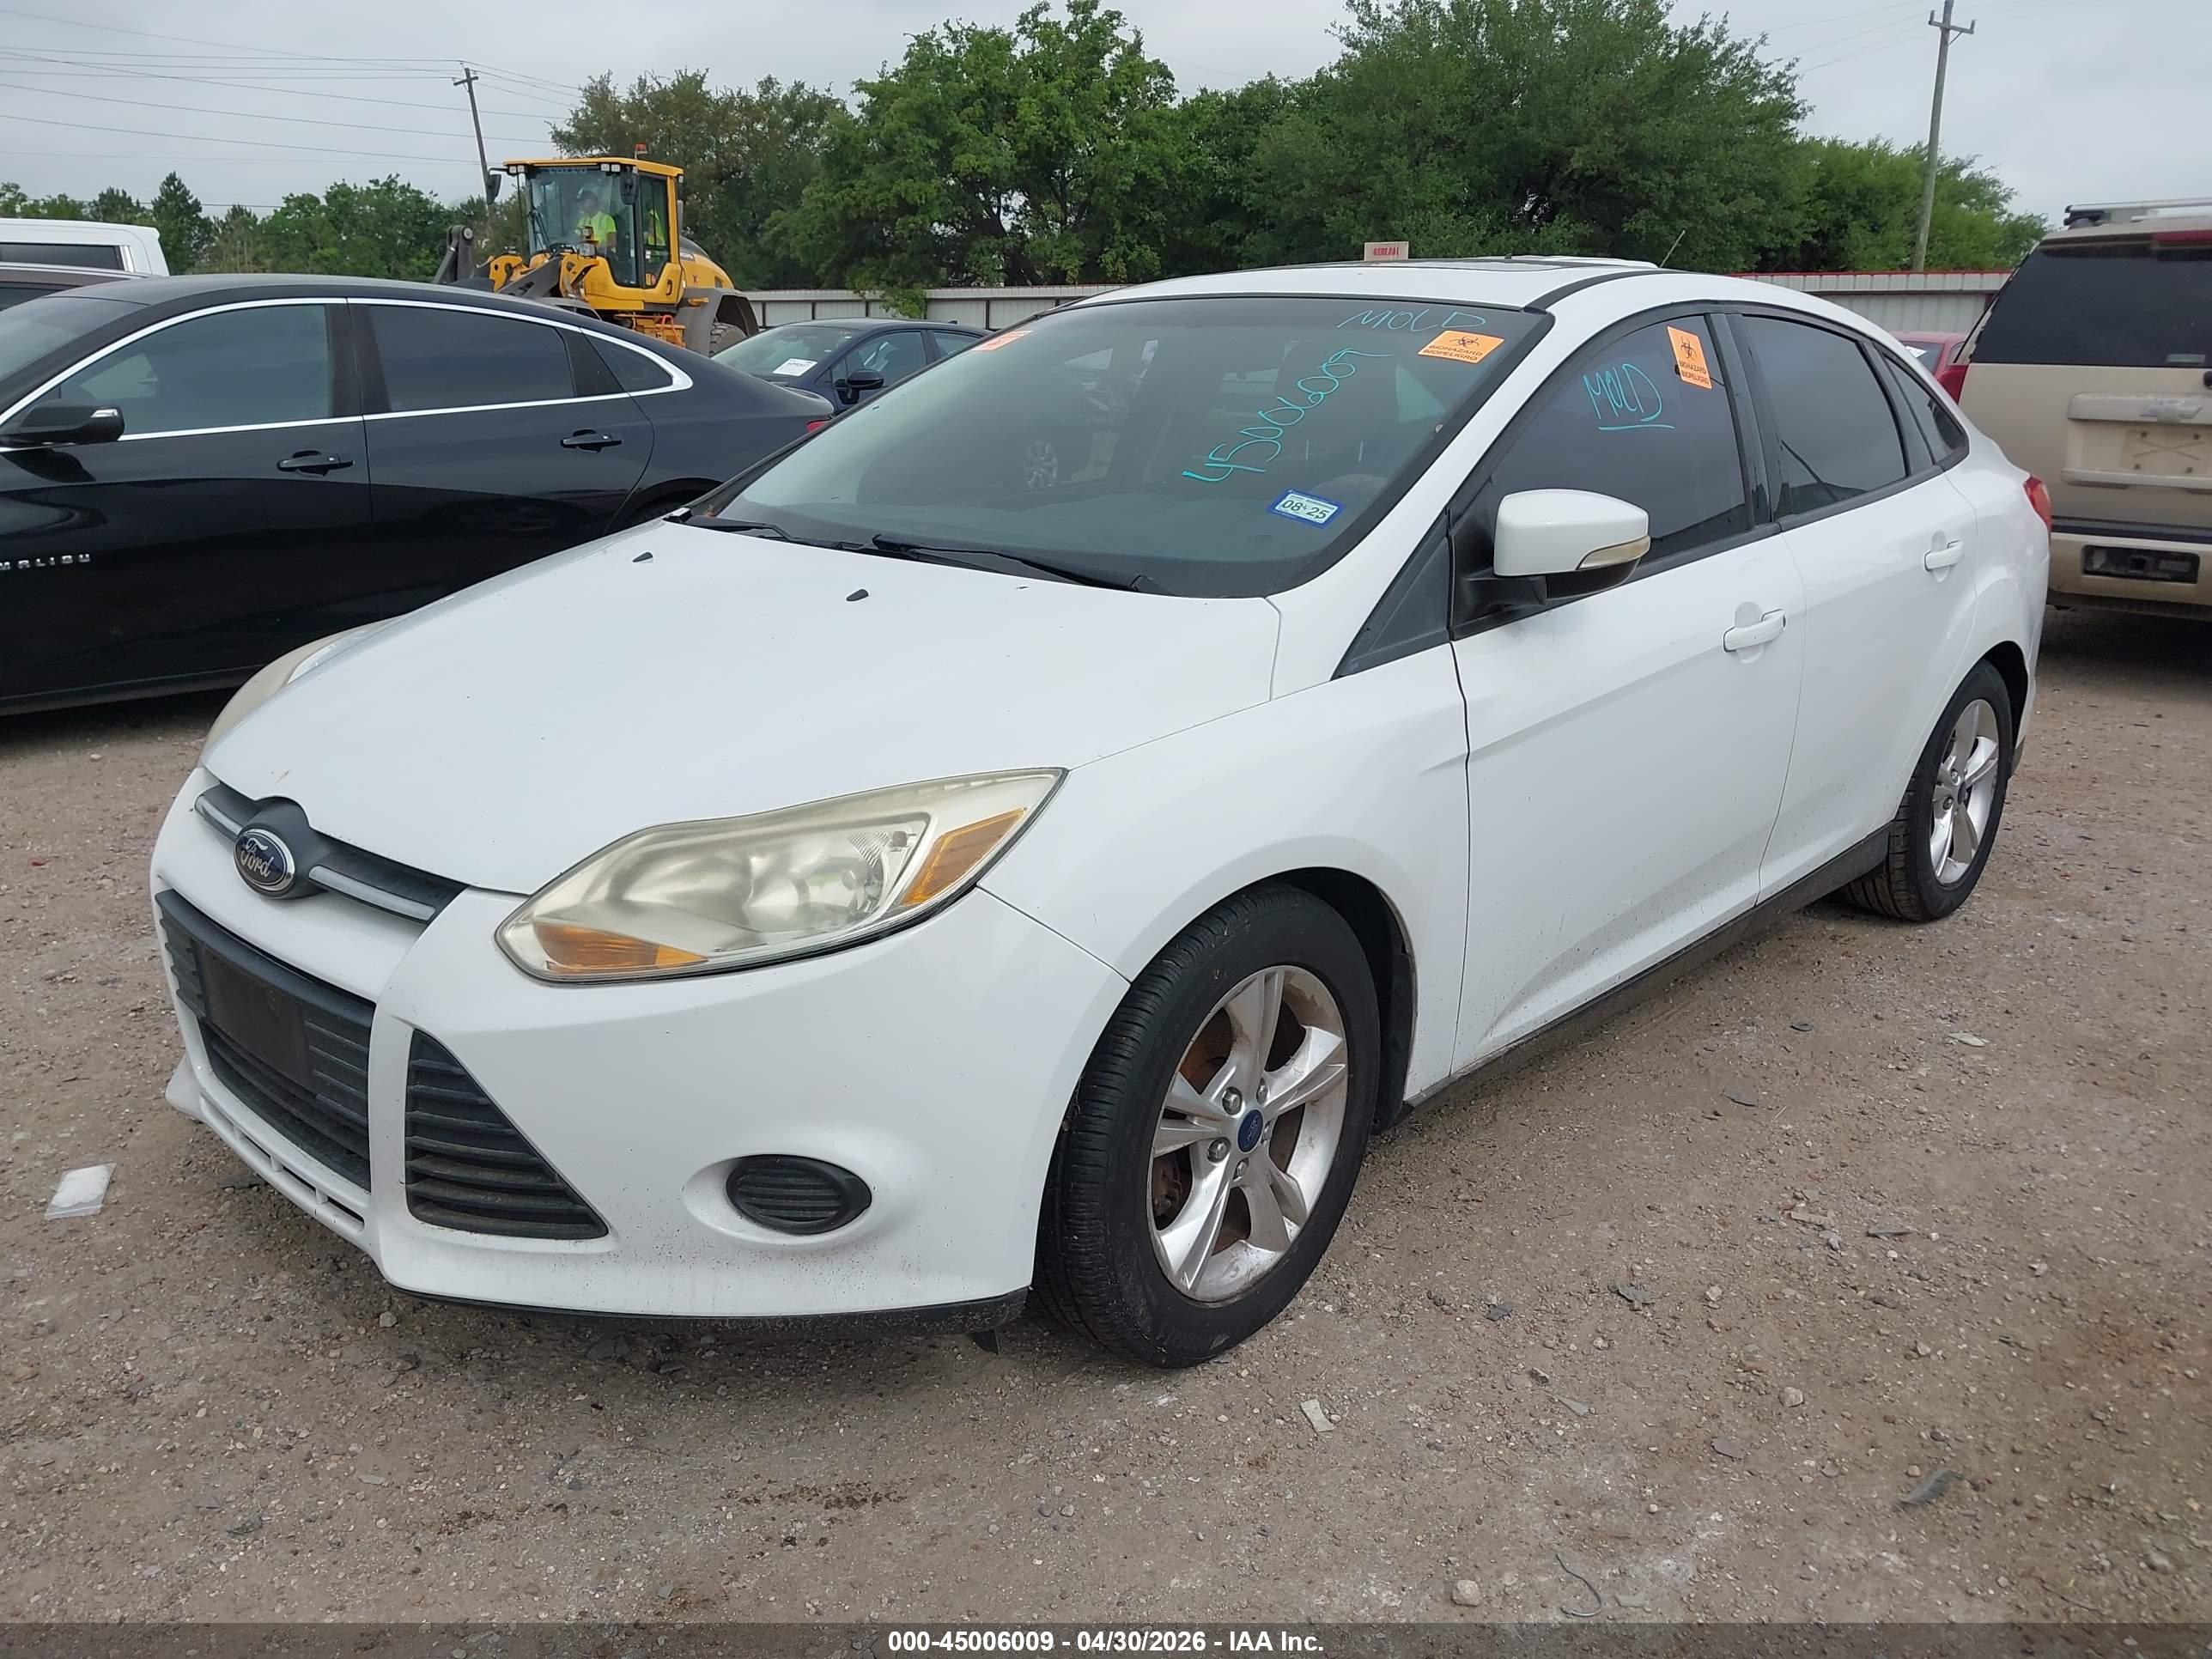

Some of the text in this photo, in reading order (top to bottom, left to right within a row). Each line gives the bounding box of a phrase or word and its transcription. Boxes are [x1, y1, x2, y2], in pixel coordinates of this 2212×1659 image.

[1336, 308, 1486, 332] MOLD
[1422, 349, 1477, 361] BIOPELIGRO
[1428, 344, 1483, 356] BIOHAZARD
[1582, 363, 1662, 422] MOLD
[240, 837, 275, 878] Ford
